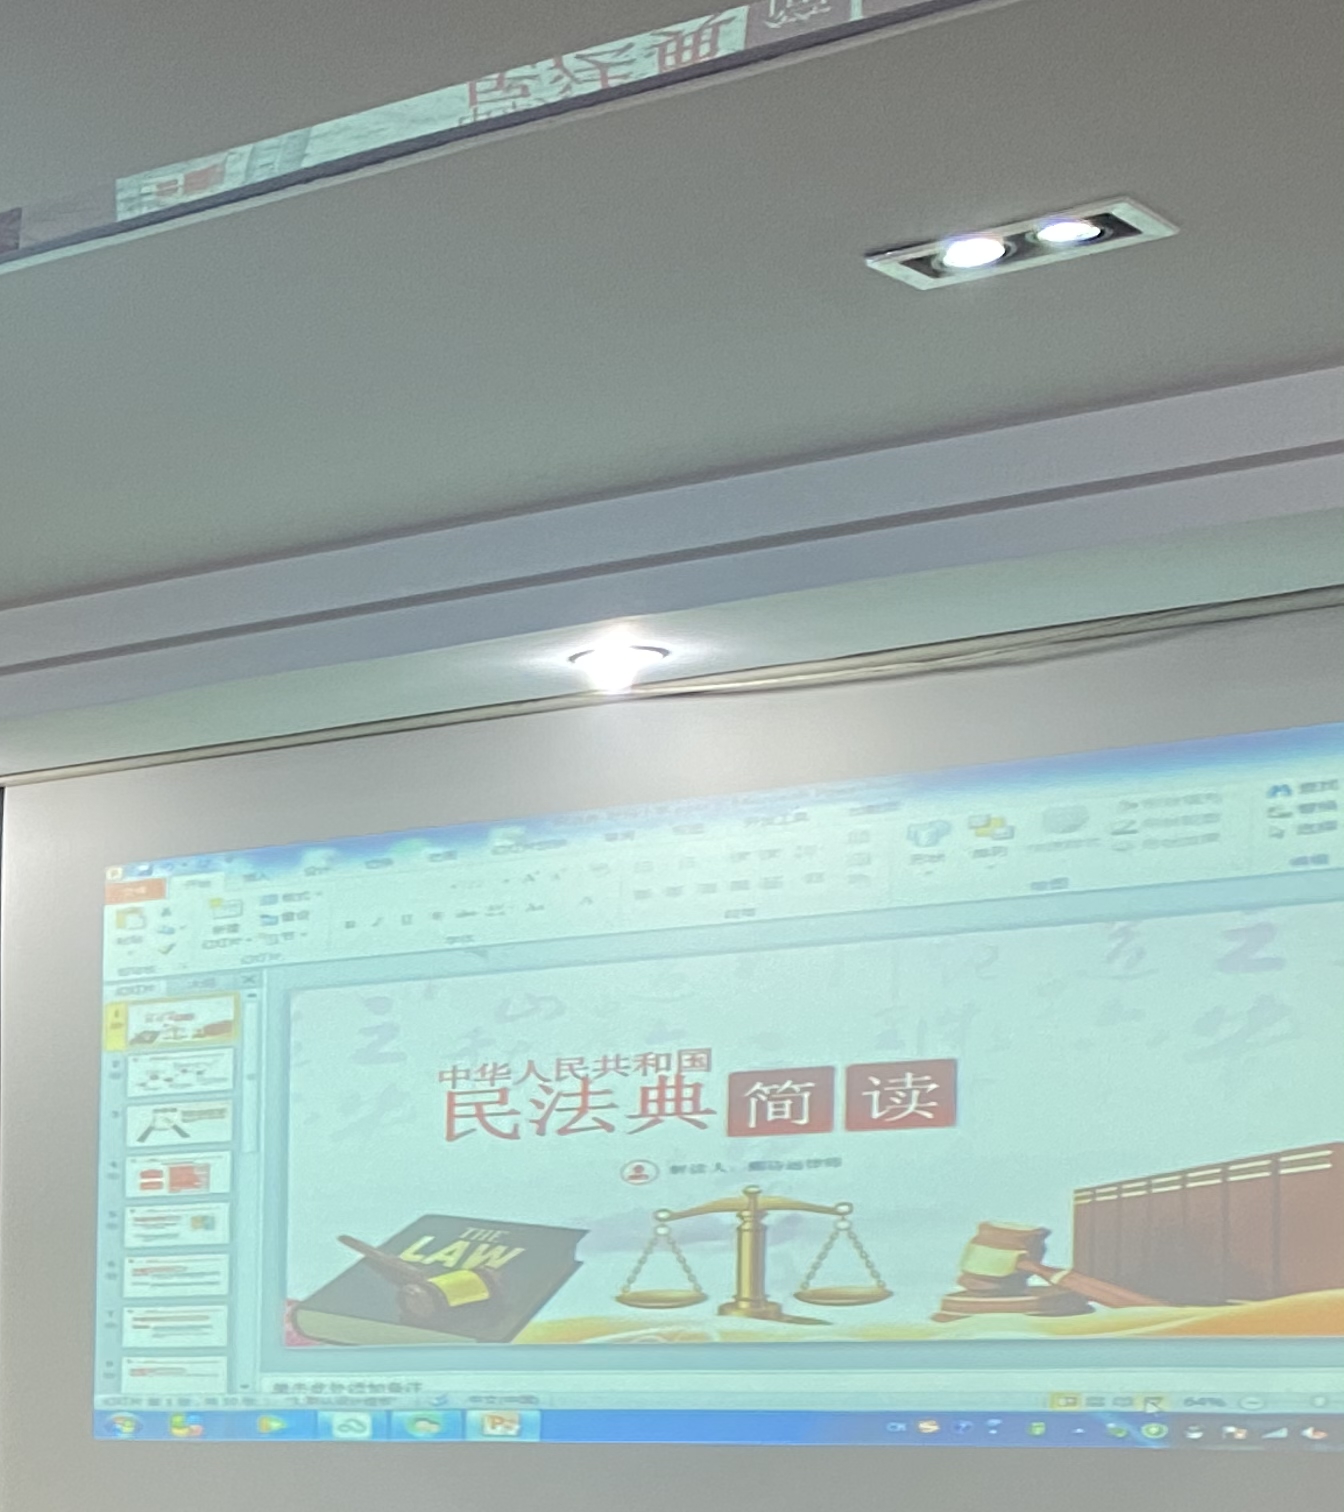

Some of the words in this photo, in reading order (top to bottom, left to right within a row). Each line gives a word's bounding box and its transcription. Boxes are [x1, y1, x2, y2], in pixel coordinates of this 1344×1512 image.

[438, 1047, 713, 1090] 中华人民共和国
[444, 1072, 718, 1143] 民法典
[744, 1071, 942, 1130] 简读
[399, 1234, 527, 1271] LAW
[459, 1227, 511, 1244] THE
